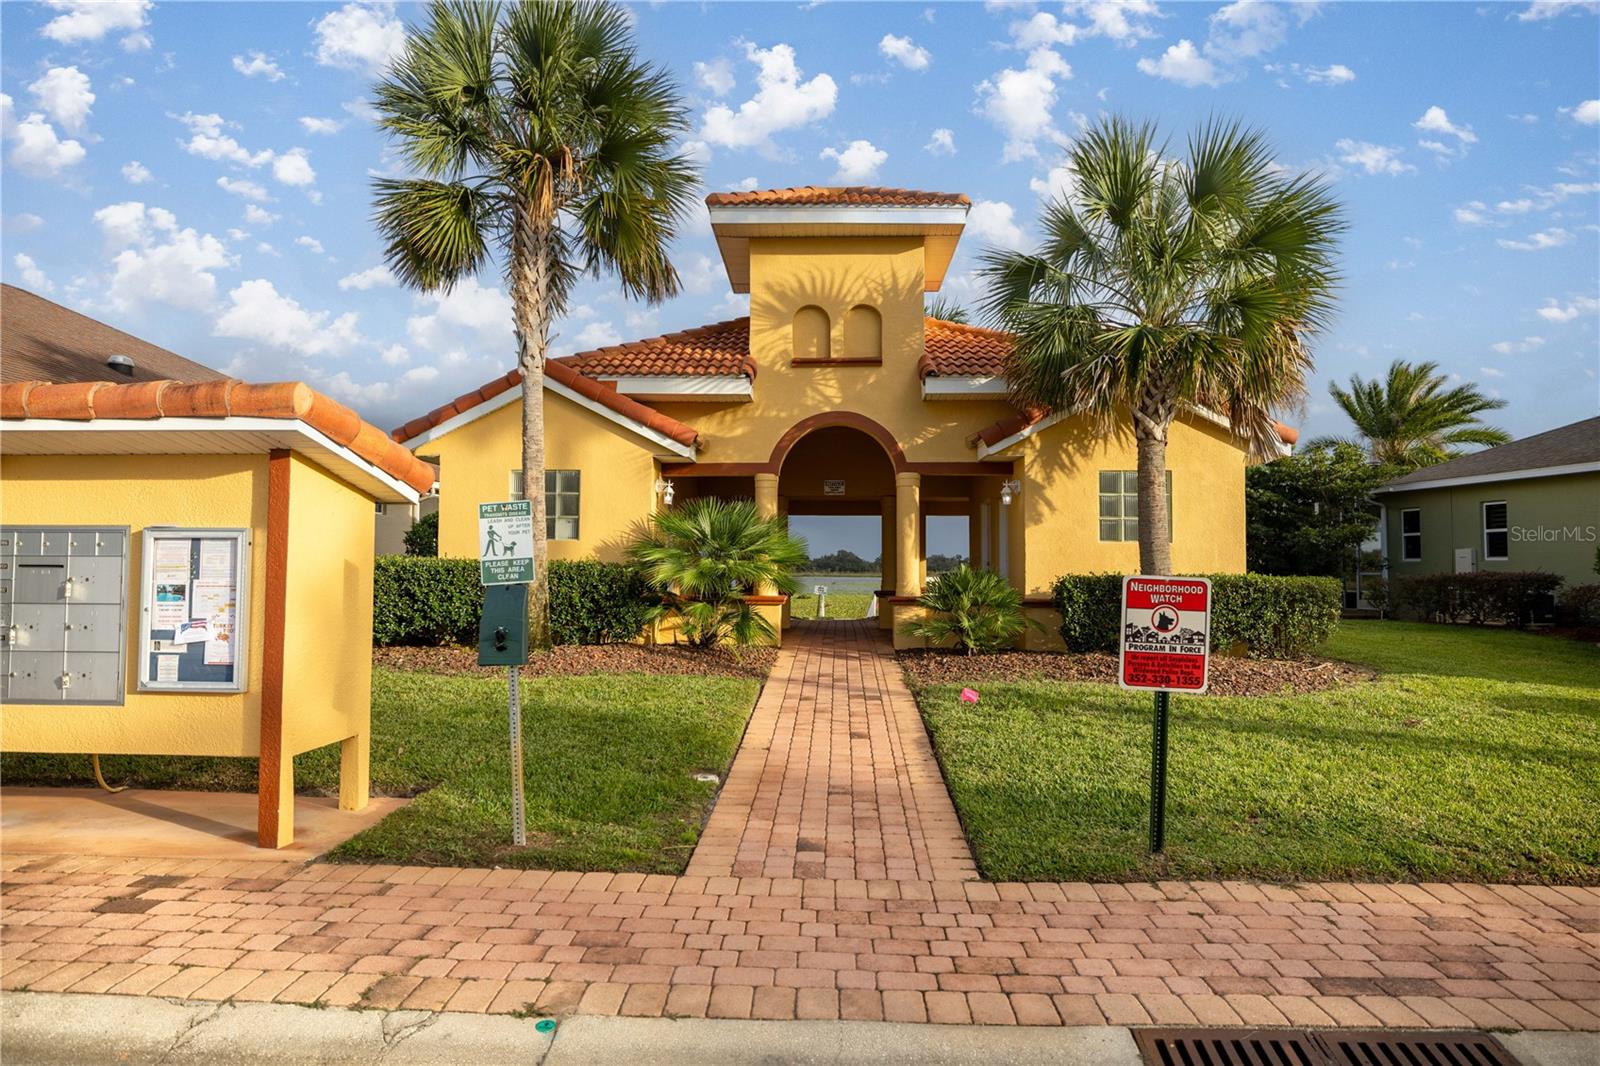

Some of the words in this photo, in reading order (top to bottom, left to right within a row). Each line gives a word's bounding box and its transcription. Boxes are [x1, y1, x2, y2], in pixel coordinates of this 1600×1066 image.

[501, 503, 528, 511] WASTE
[497, 573, 519, 581] CLEAN
[1130, 581, 1204, 594] NEIGHBORHOOD
[1150, 594, 1183, 604] WATCH
[1128, 643, 1166, 652] PROGRAM
[1169, 645, 1177, 653] IN
[1180, 646, 1202, 654] FORCE
